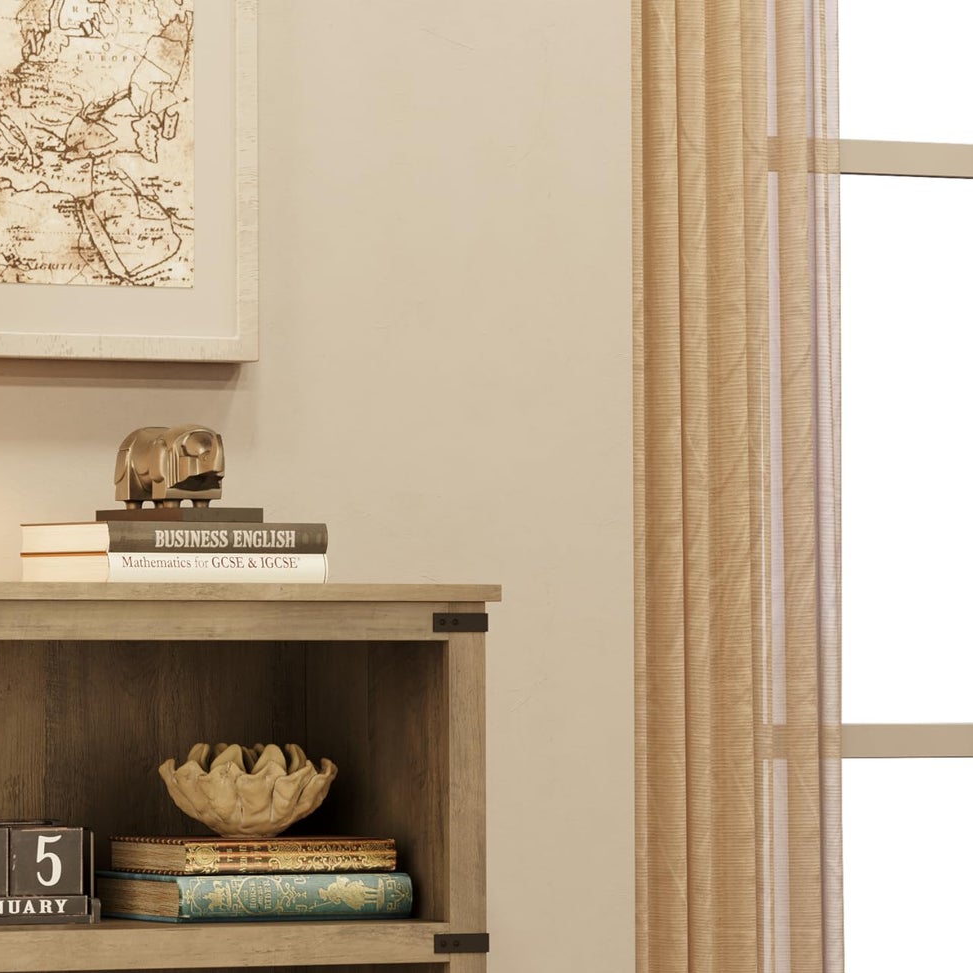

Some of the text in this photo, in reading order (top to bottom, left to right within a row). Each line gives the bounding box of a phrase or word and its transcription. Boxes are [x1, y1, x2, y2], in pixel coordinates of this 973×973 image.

[154, 529, 296, 548] BUSINESS ENGLISH
[122, 556, 192, 569] Mathematics
[194, 556, 209, 569] for
[211, 556, 245, 569] GCSE
[247, 557, 258, 569] &
[36, 834, 63, 887] 5
